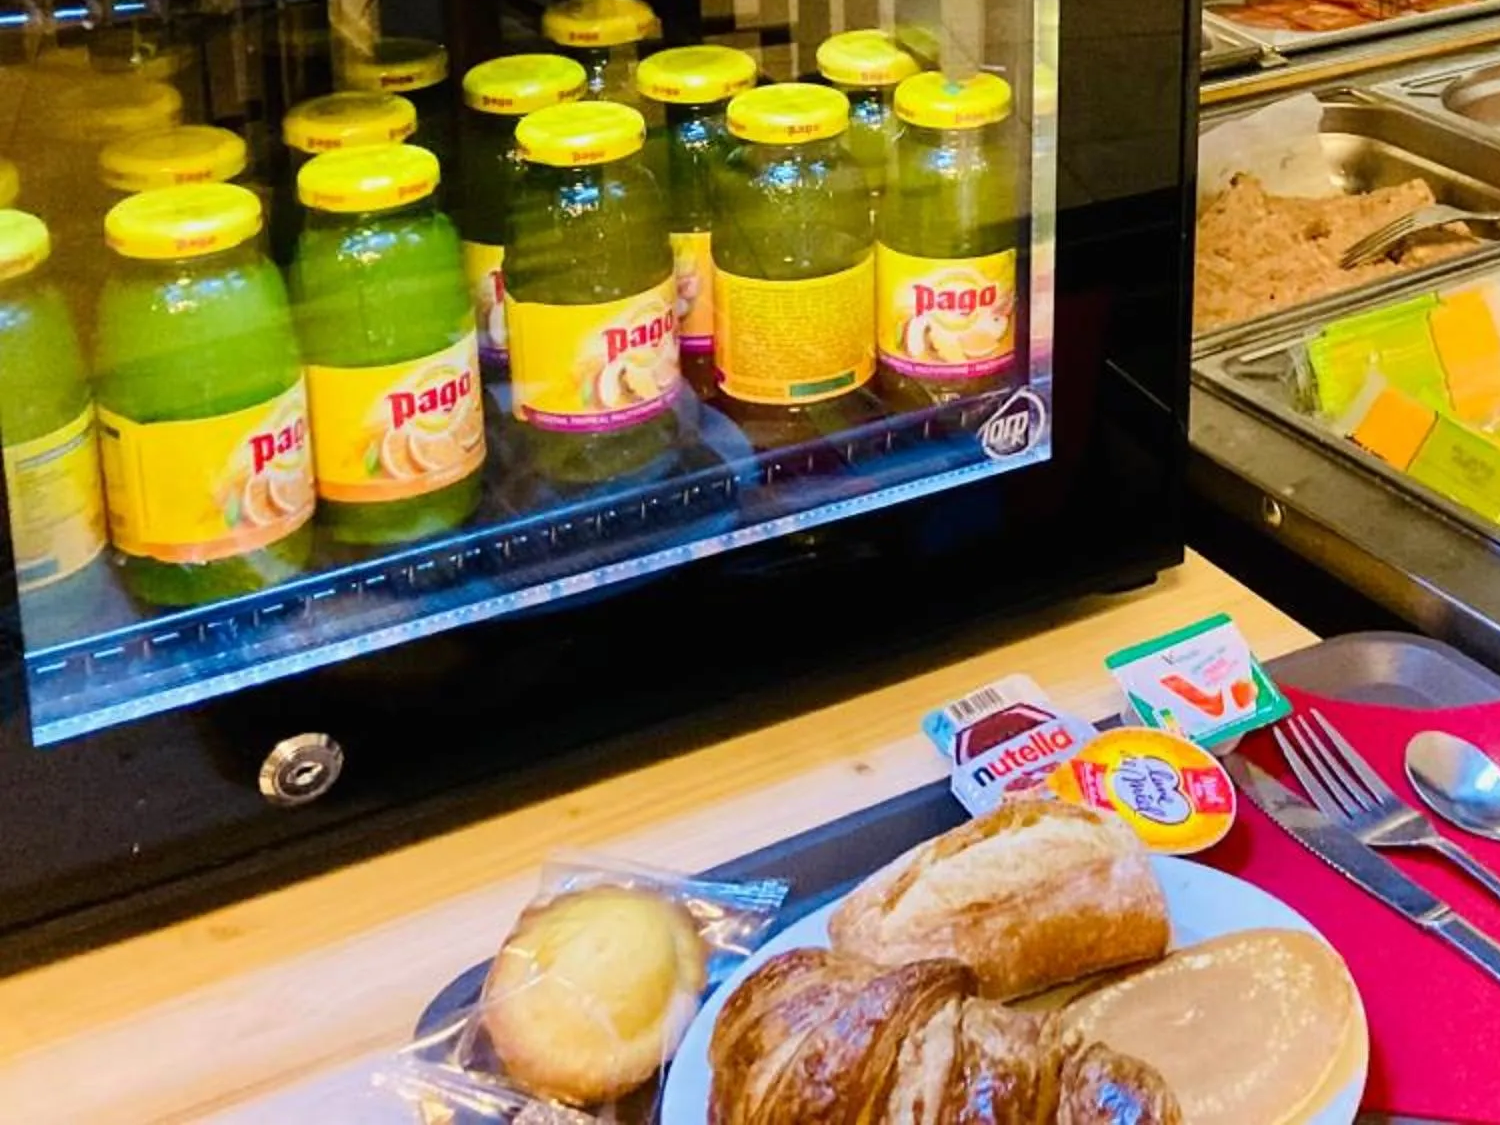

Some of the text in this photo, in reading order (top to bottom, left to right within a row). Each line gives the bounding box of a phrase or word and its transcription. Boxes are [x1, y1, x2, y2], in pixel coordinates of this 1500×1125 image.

[913, 283, 997, 317] pago
[603, 309, 674, 363] pago
[387, 371, 471, 431] pago
[248, 418, 305, 475] pag
[973, 728, 1073, 787] nutella
